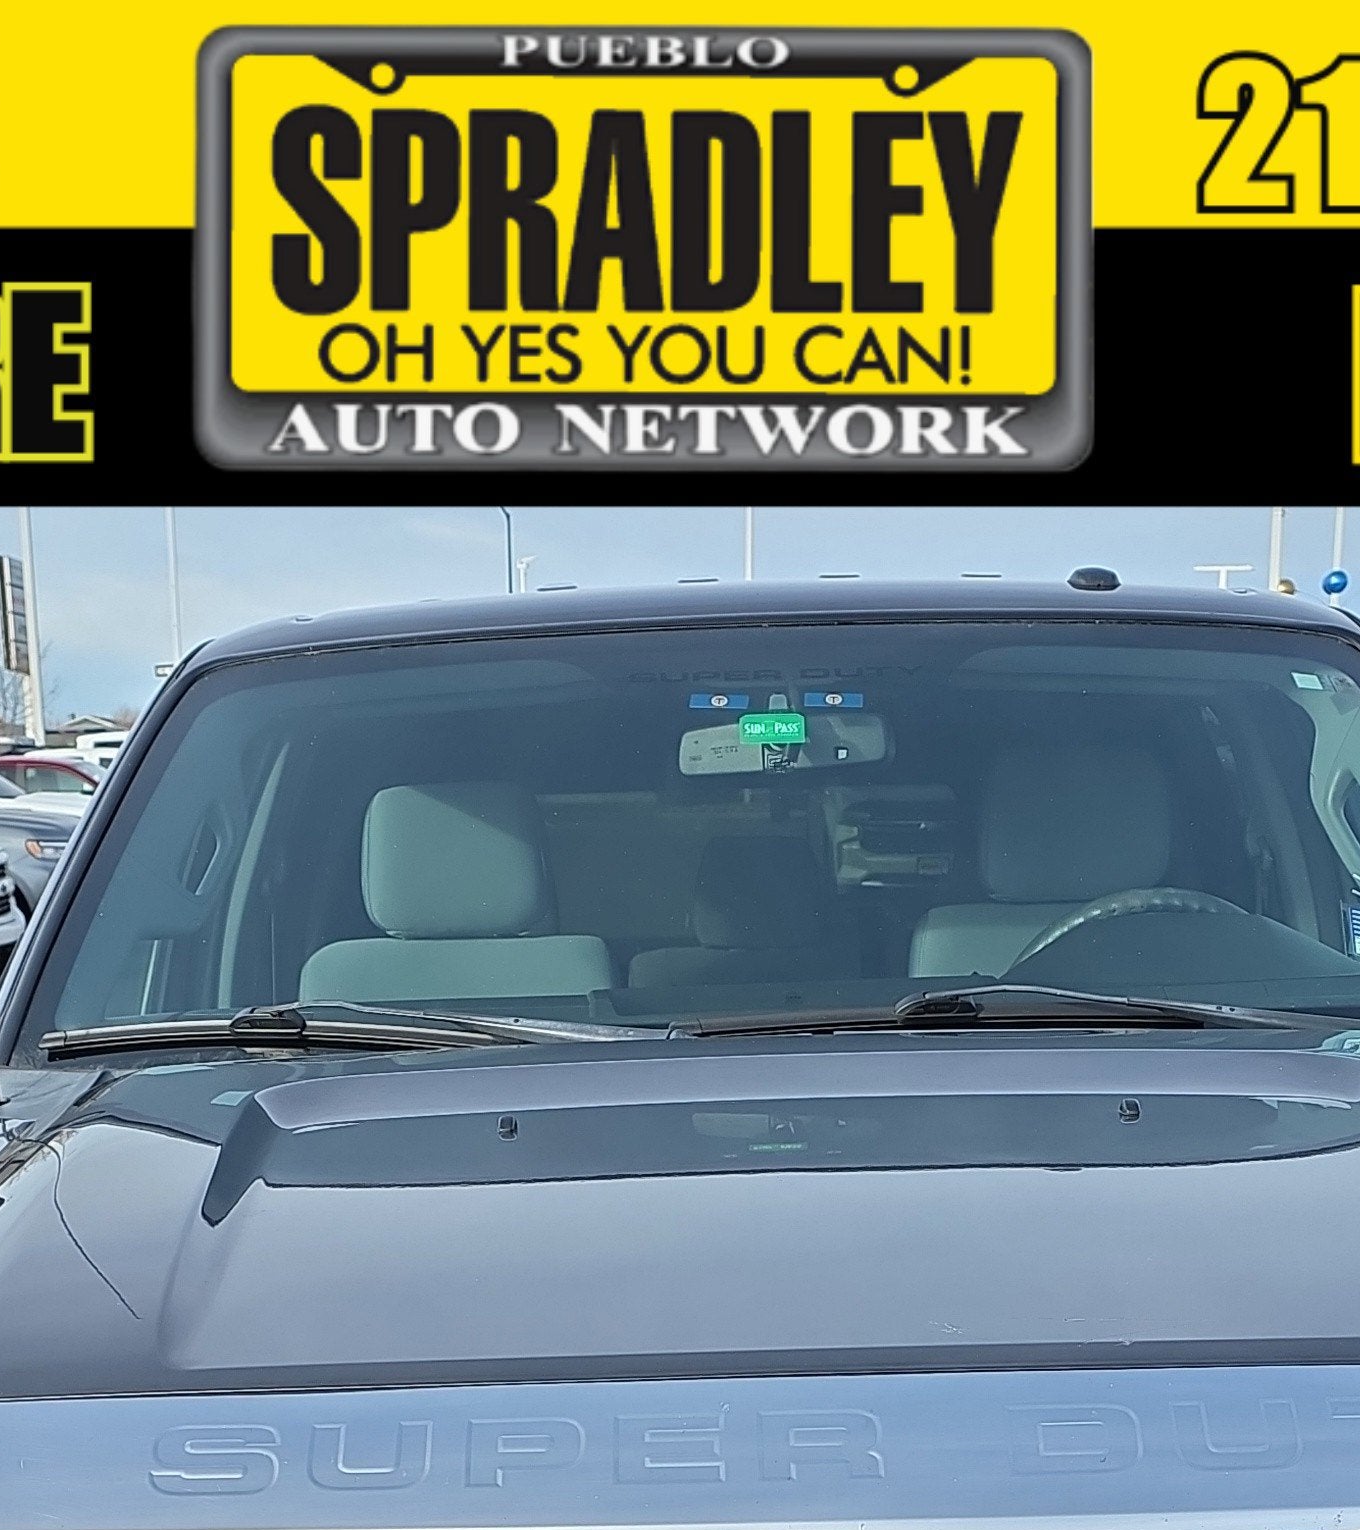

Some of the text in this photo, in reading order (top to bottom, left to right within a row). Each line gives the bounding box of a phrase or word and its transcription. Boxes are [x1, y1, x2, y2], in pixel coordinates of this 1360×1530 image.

[744, 722, 799, 734] SUN PASS
[148, 1400, 885, 1496] SUPER
